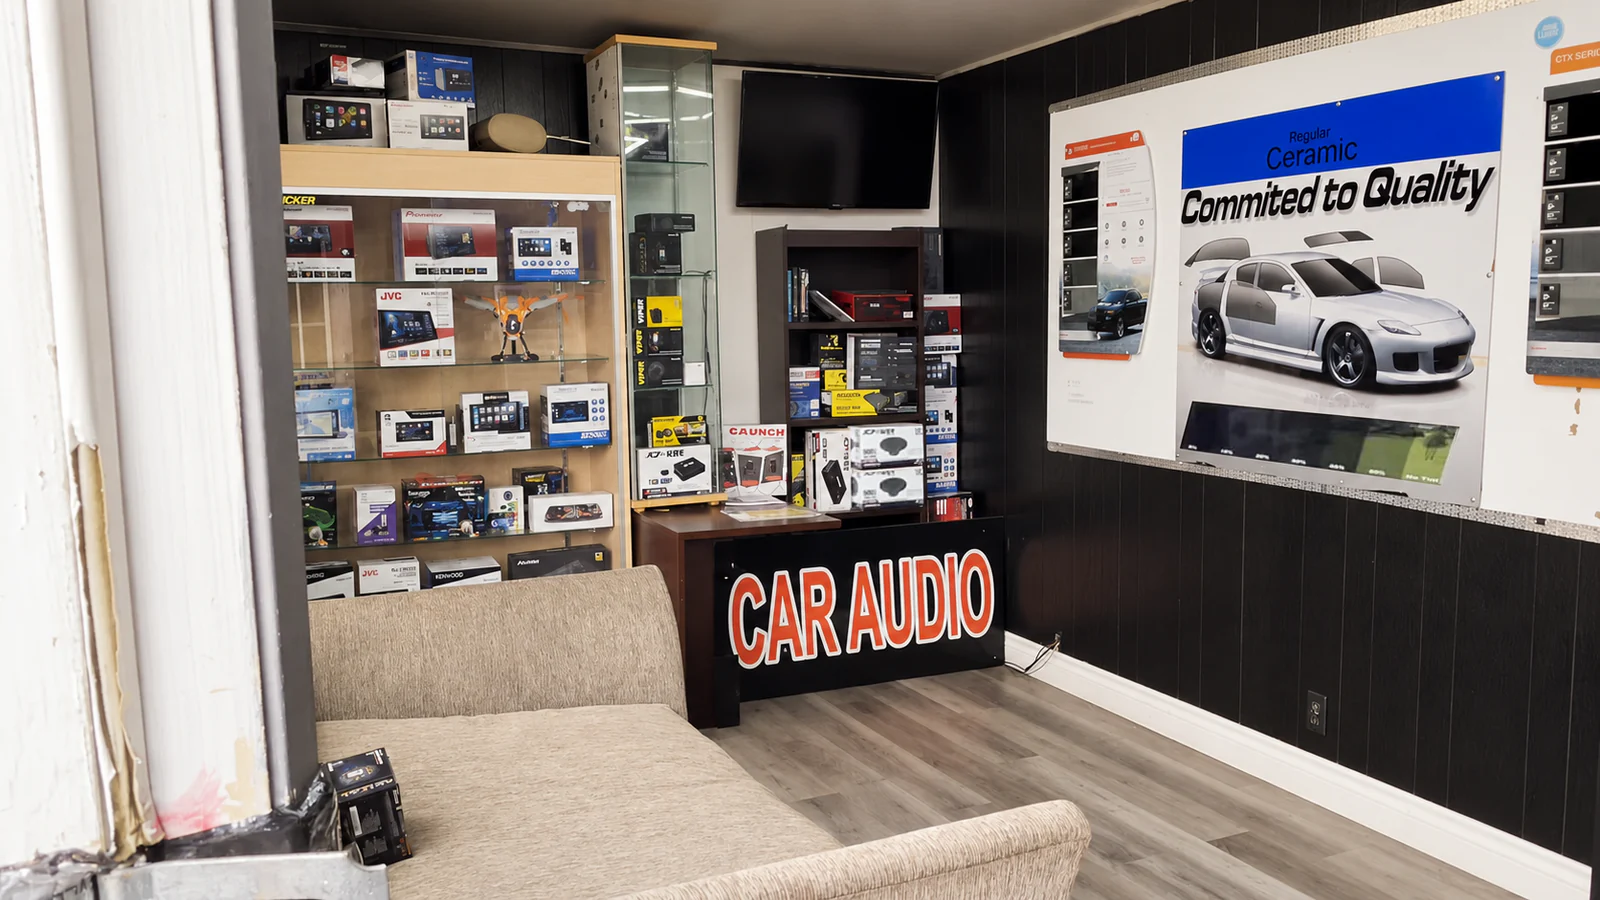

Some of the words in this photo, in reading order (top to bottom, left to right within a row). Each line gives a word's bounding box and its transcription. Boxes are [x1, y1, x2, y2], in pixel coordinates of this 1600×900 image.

[1555, 53, 1574, 64] CTX
[1289, 127, 1331, 145] Regular
[1267, 138, 1358, 170] Ceramic
[1181, 175, 1321, 225] Commited
[1323, 177, 1358, 212] to
[1362, 159, 1495, 213] Quality
[380, 291, 402, 301] JVC
[362, 569, 379, 577] JVC
[728, 566, 842, 669] CAR
[846, 548, 995, 653] AUDIO
